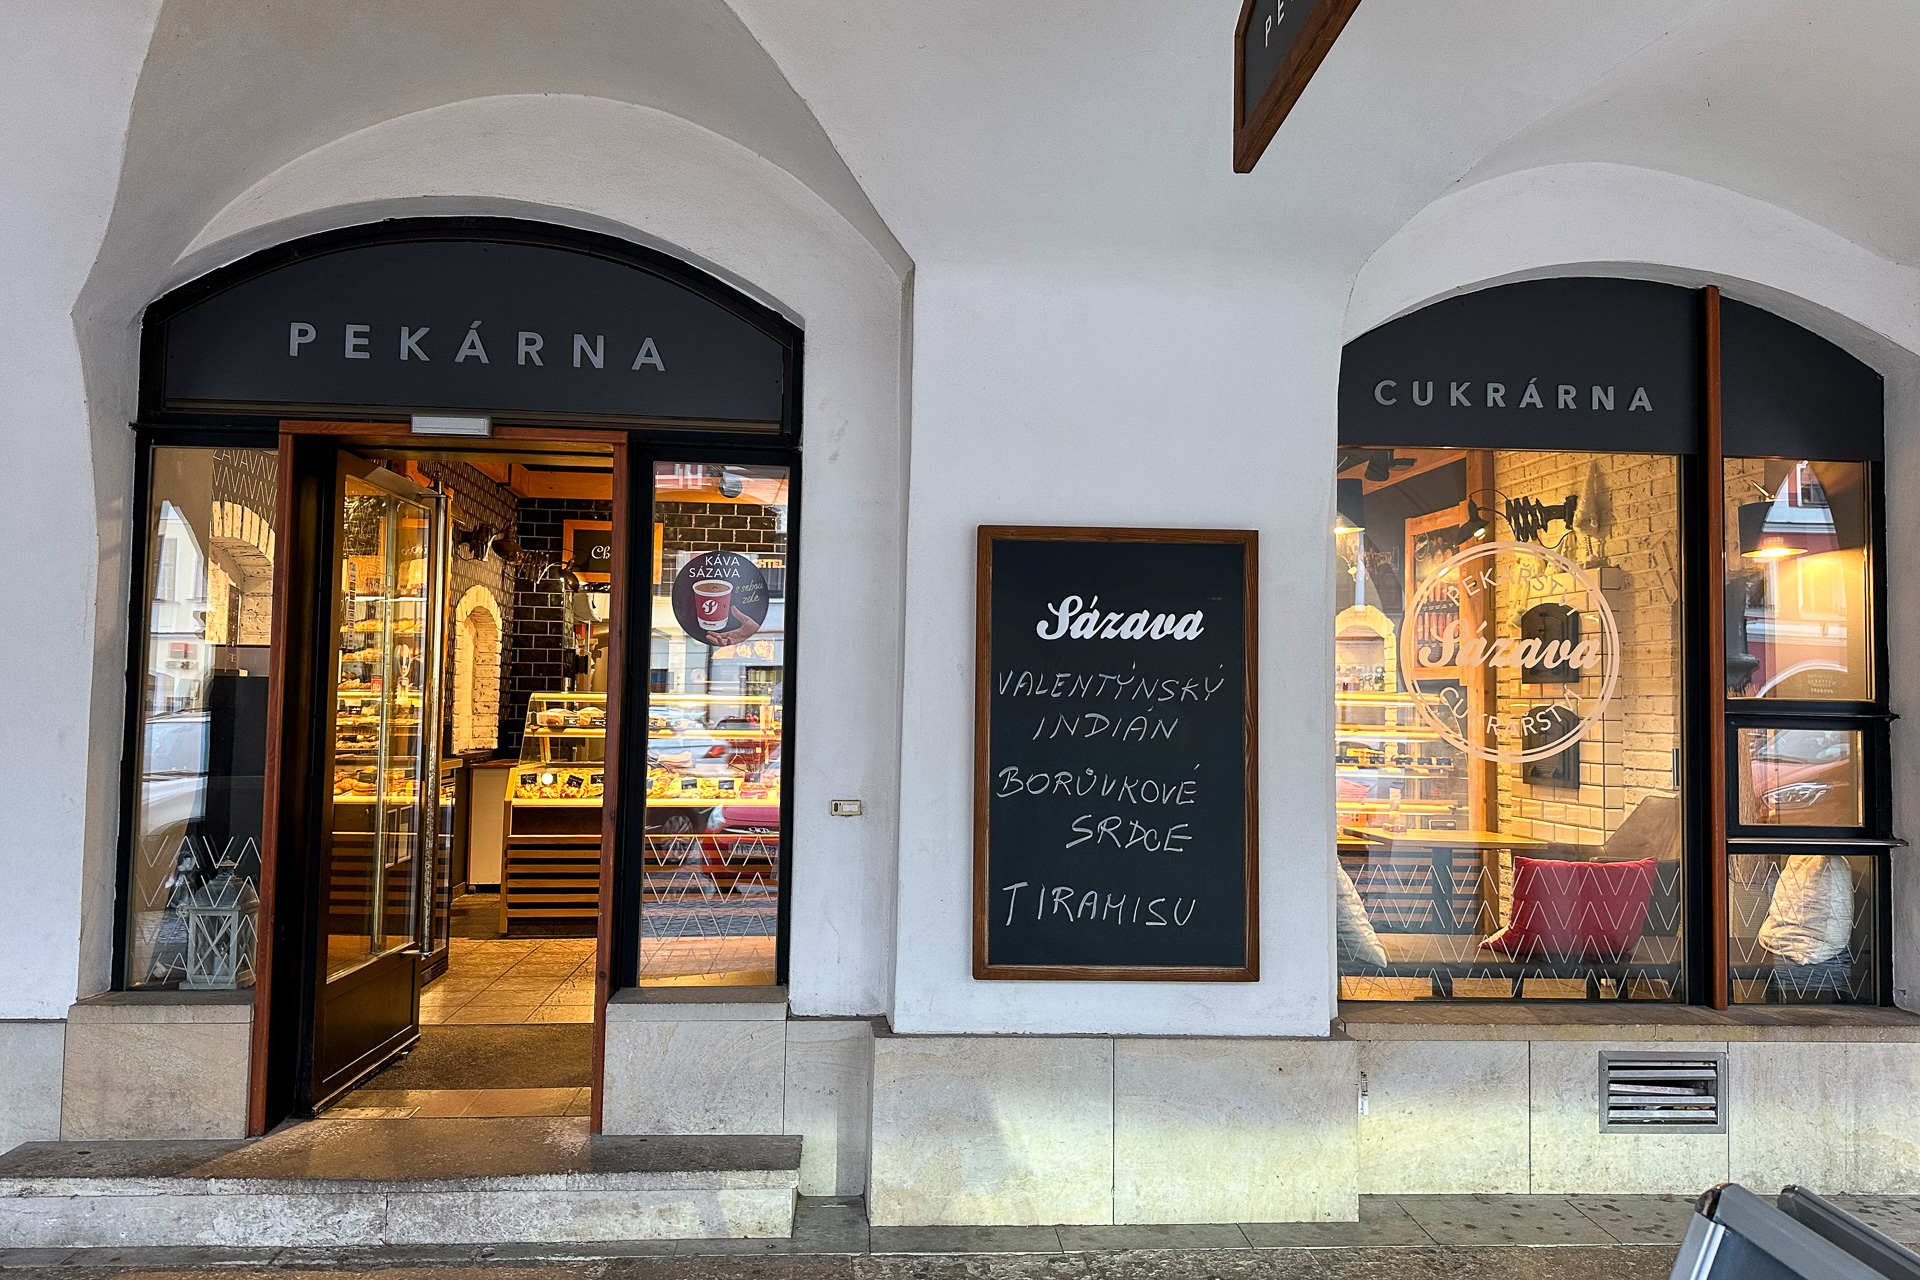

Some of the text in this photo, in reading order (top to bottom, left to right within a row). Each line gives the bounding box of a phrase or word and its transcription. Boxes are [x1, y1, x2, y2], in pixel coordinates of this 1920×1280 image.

[289, 320, 666, 372] PEKÁRNA
[1374, 378, 1653, 411] CUKRÁRNA
[689, 565, 741, 578] SÁZAVA
[705, 554, 740, 566] KÁVA
[1446, 564, 1581, 616] PEKAŘSTVÍ
[1036, 595, 1205, 641] Sázava
[1418, 619, 1600, 669] Sázava
[998, 661, 1225, 702] VALENTÝNSKÝ
[1033, 706, 1178, 741] INDIÁN
[996, 765, 1199, 805] BORŮVKOVÉ
[1066, 815, 1193, 853] SRDCE
[1002, 882, 1197, 927] TIRAMISU
